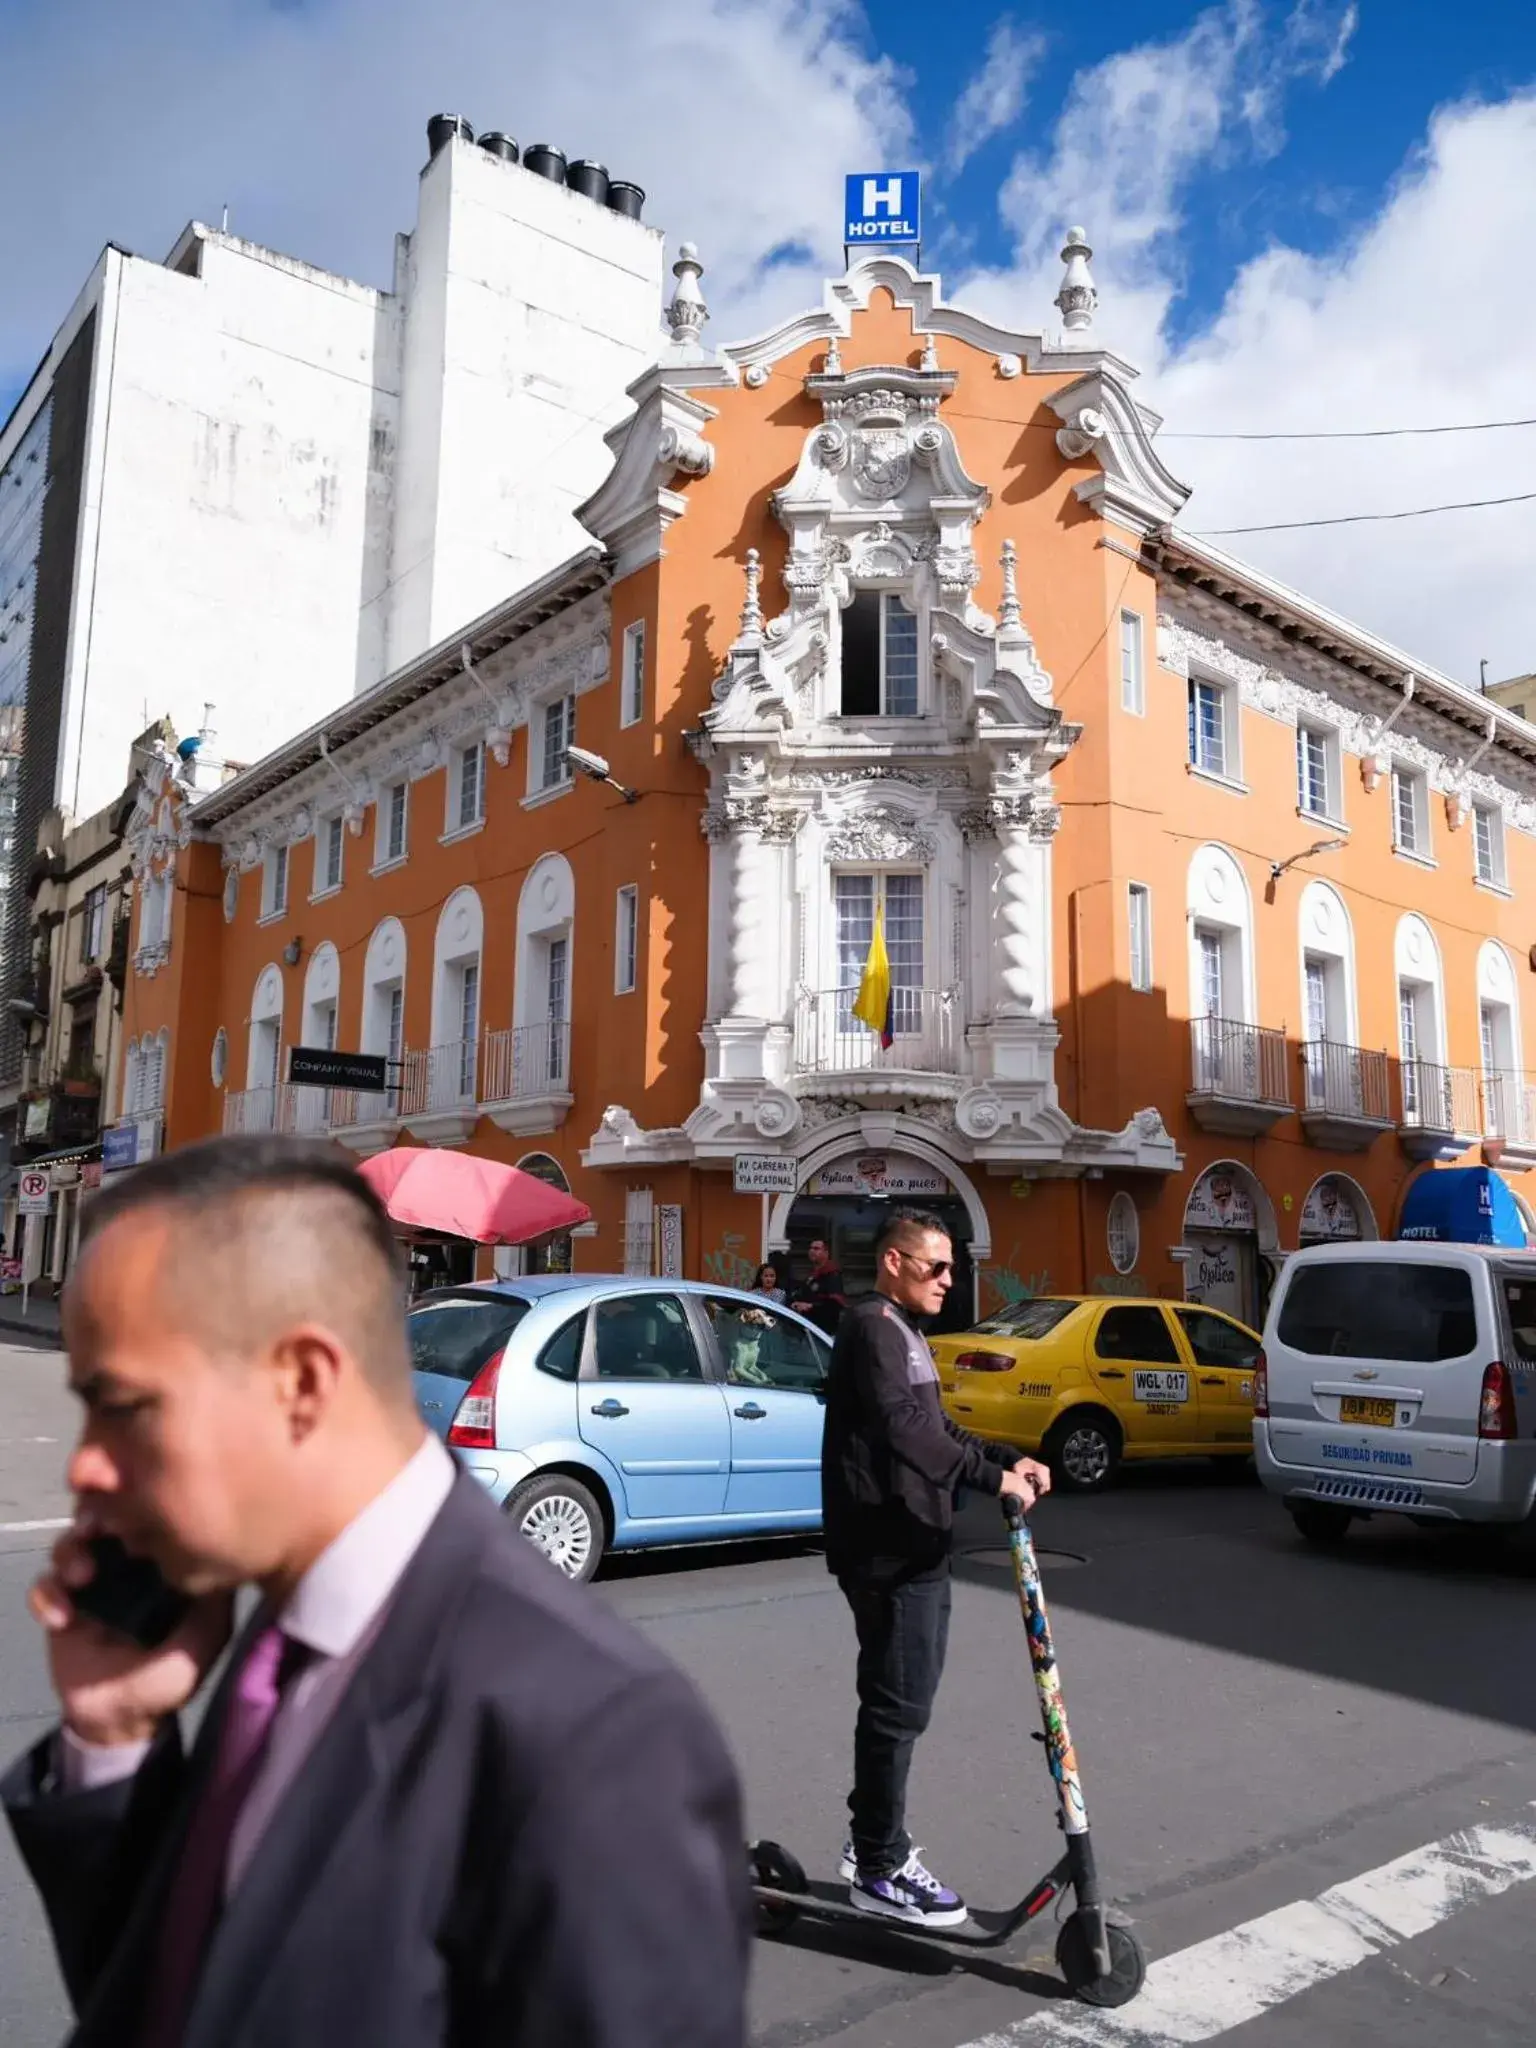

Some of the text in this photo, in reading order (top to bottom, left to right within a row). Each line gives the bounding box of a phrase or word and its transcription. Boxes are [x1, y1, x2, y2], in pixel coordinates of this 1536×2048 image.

[862, 178, 902, 216] H
[848, 221, 914, 236] HOTEL
[293, 1060, 342, 1075] COMPANY
[752, 1161, 787, 1170] CARRERA
[753, 1174, 793, 1186] PEATONAL
[1480, 1184, 1491, 1205] H
[1401, 1226, 1440, 1239] HOTEL
[1322, 1444, 1370, 1462] SEGURIDAD
[1373, 1450, 1413, 1467] PRIVADA
